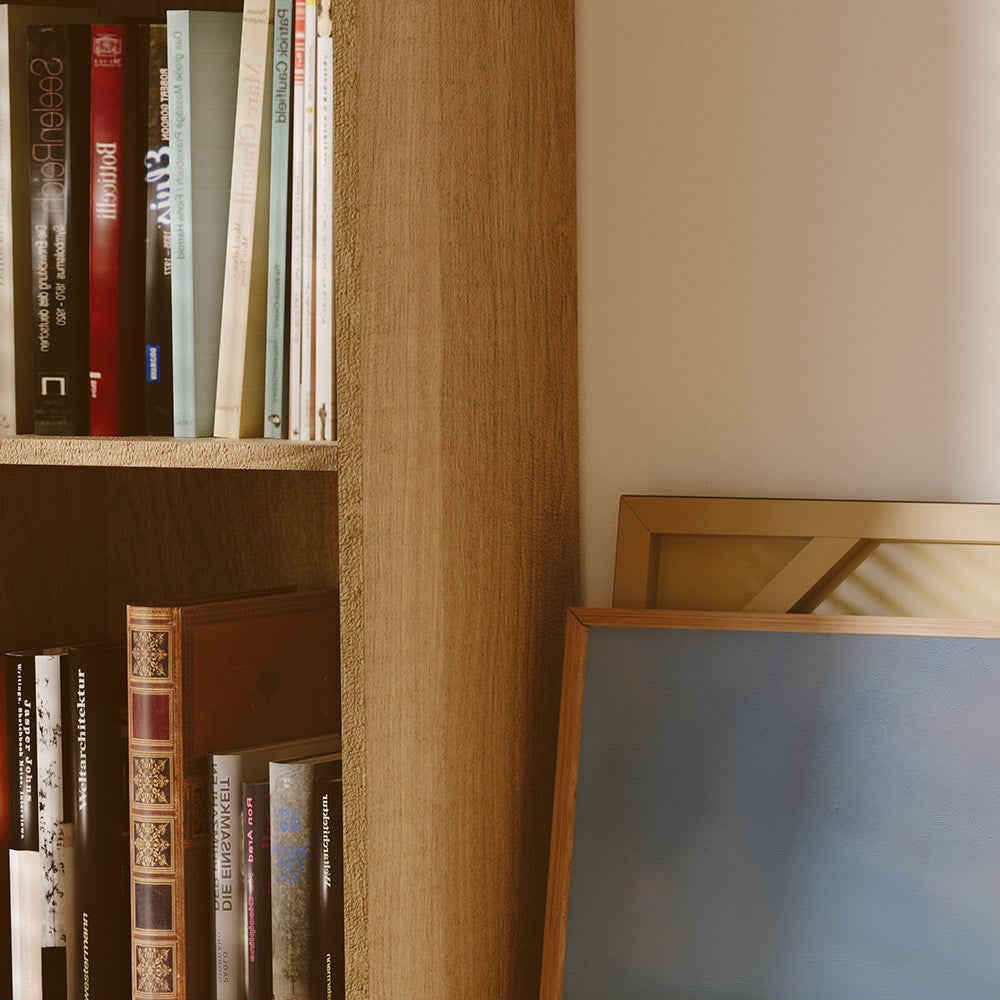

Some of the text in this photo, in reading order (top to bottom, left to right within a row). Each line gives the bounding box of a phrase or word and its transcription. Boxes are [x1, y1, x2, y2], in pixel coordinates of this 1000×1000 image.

[23, 700, 35, 803] Jasper Johns
[77, 668, 88, 812] Weltarchitektur
